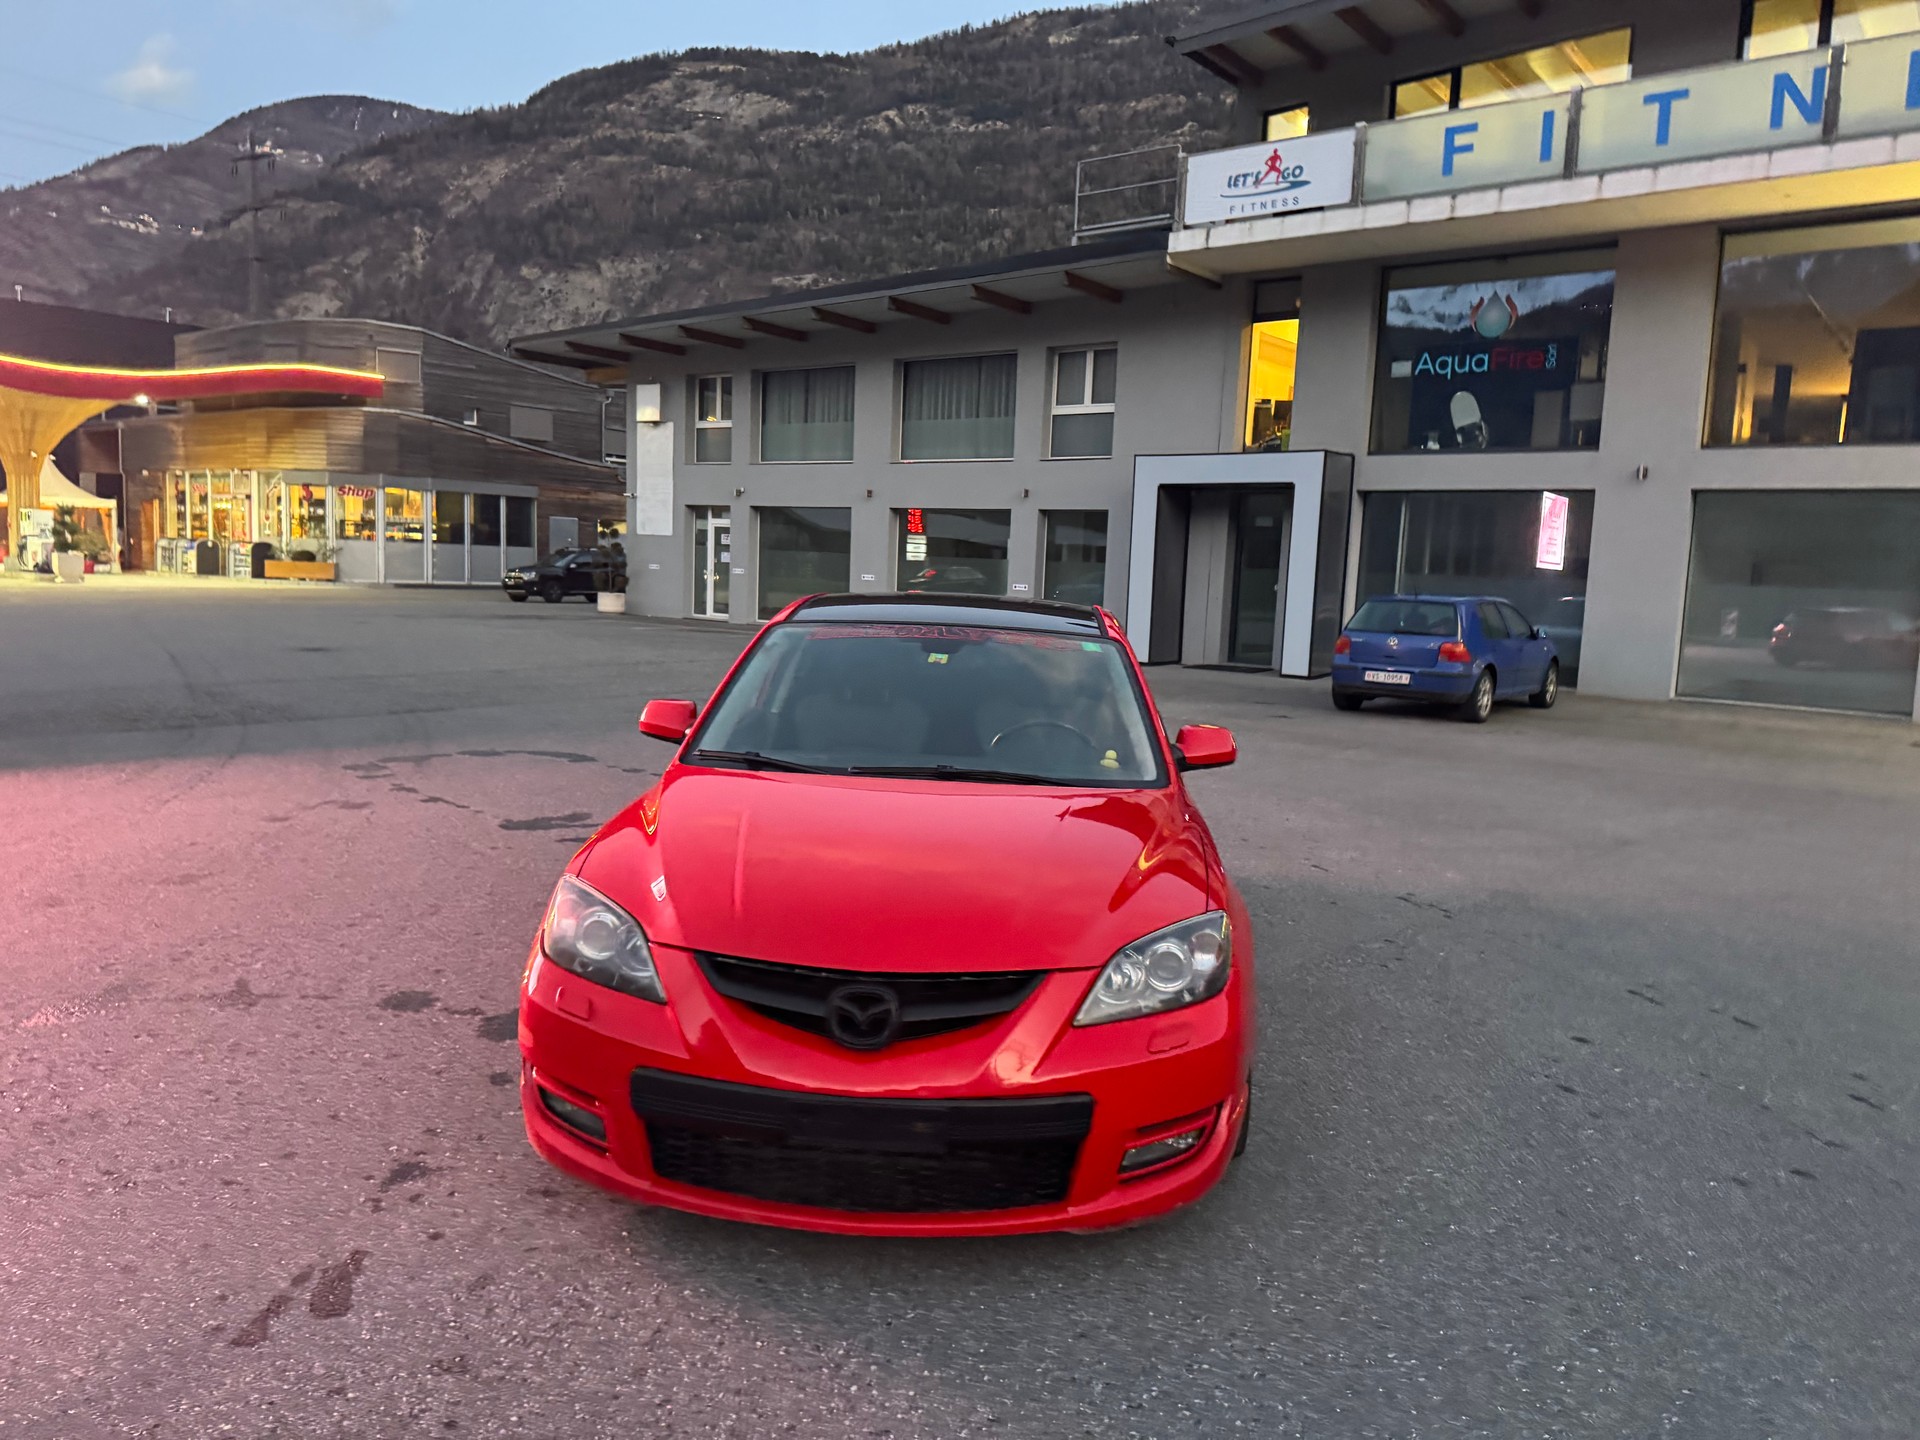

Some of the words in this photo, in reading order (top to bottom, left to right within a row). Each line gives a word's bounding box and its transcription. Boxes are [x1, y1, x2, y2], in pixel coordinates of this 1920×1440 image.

[1227, 170, 1262, 189] LET'S
[1281, 165, 1304, 181] GO
[1229, 196, 1300, 215] FITNESS
